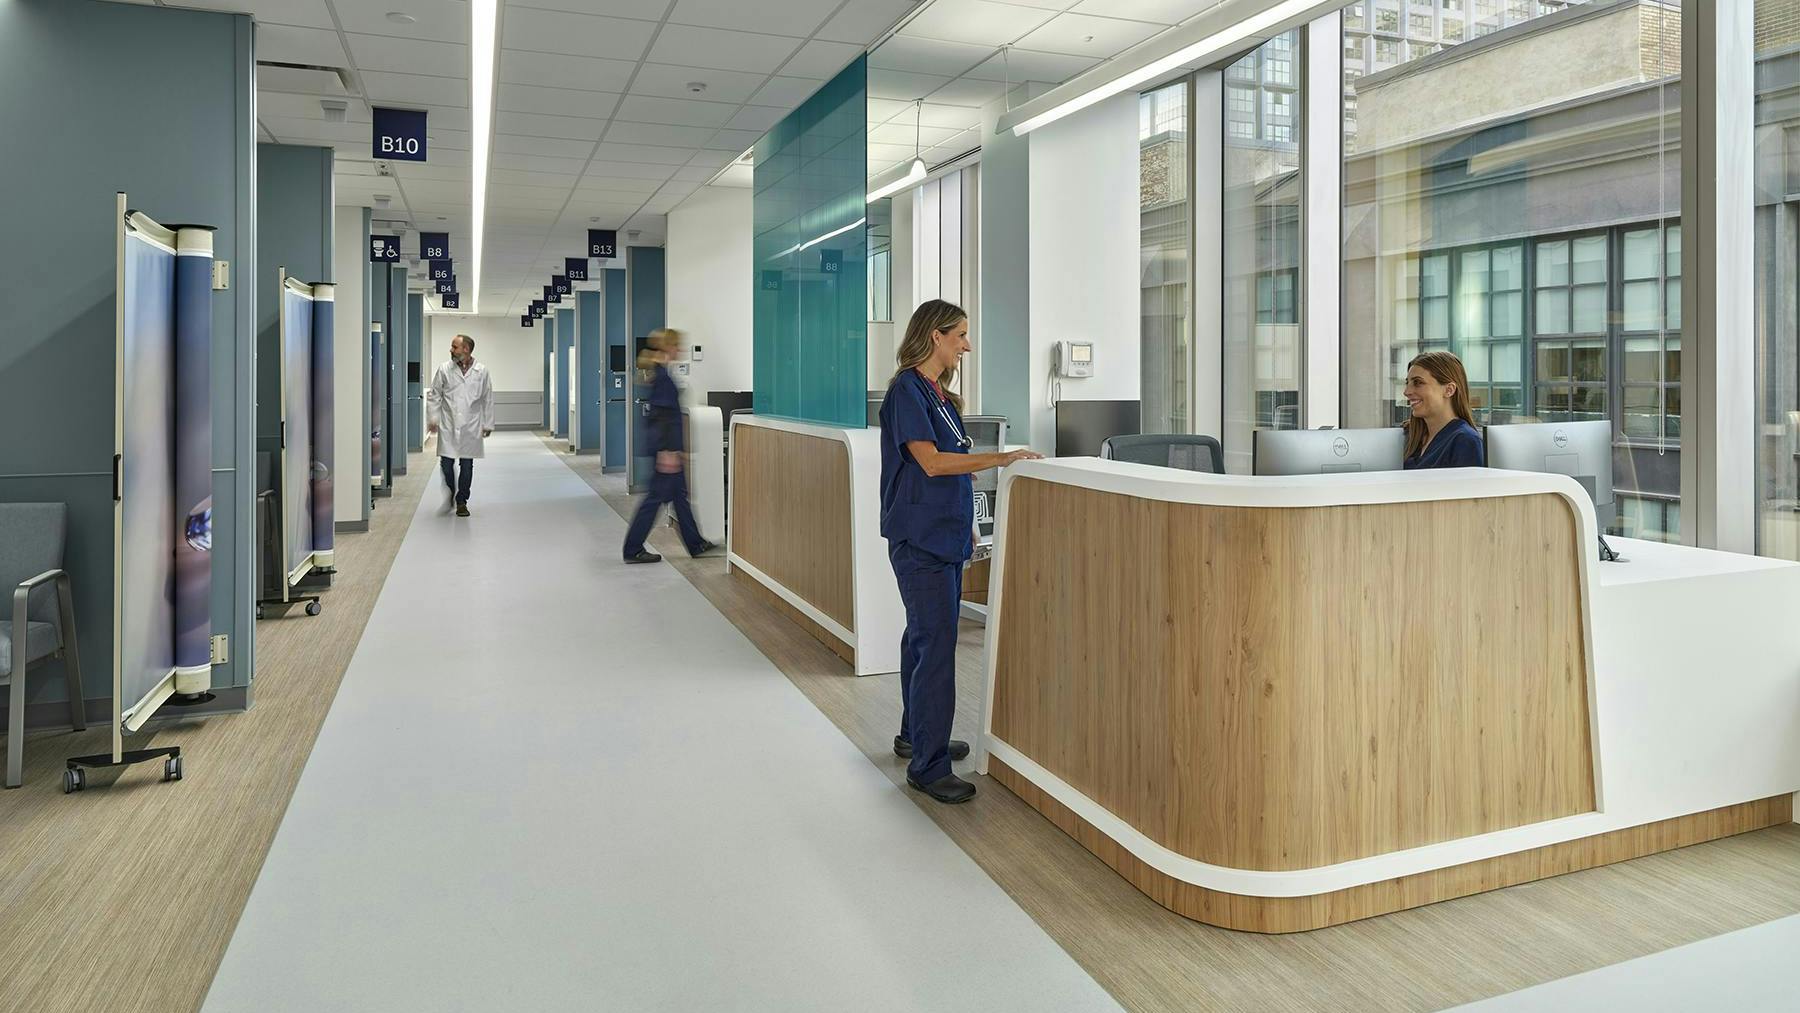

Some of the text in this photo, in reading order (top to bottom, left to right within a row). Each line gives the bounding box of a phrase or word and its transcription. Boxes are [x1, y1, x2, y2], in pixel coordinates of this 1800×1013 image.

[381, 136, 419, 154] B10
[427, 247, 442, 257] B8
[592, 245, 612, 254] B13
[435, 270, 448, 279] B6
[556, 285, 567, 293] B9
